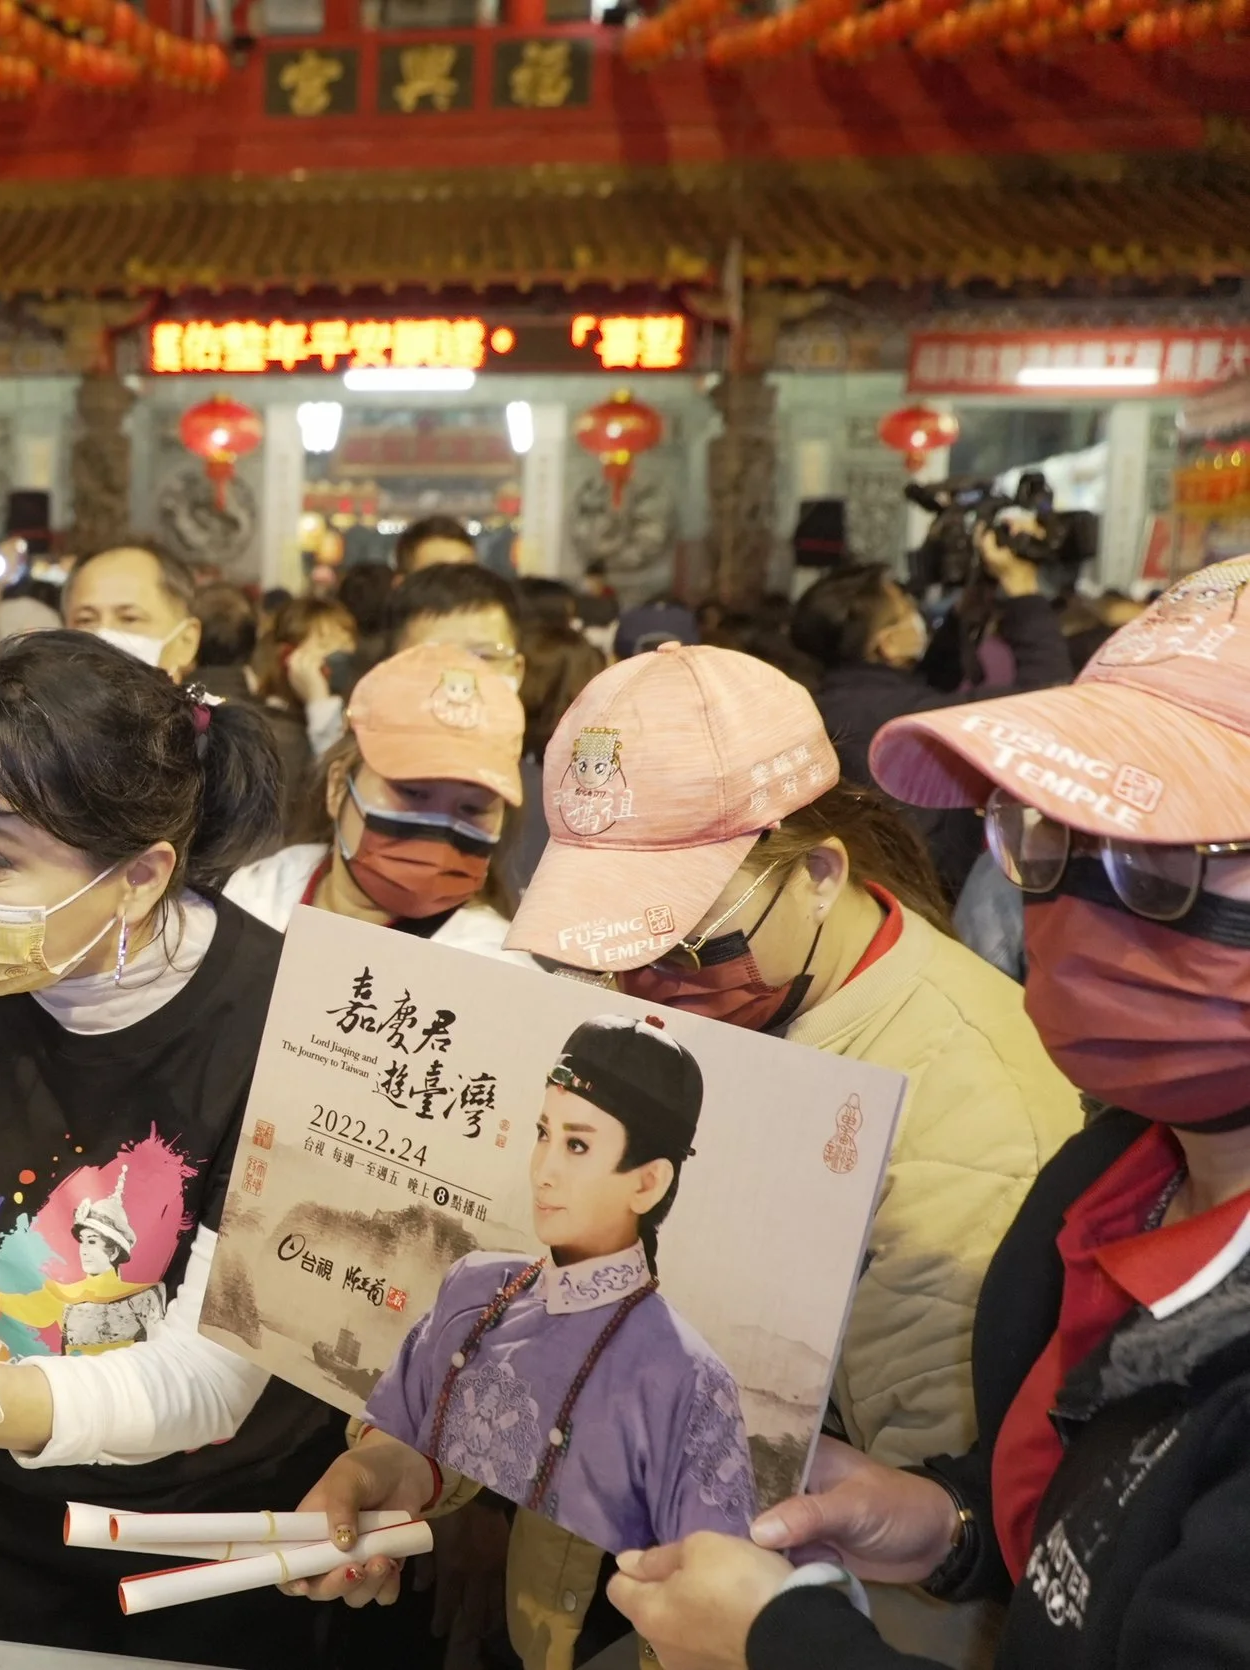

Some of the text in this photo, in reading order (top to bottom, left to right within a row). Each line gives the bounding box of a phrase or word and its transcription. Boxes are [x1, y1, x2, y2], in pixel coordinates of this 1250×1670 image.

[961, 714, 1117, 781] FUSING
[993, 740, 1144, 832] TEMPLE
[558, 916, 644, 951] FUSING
[582, 934, 673, 966] TEMPLE
[326, 966, 458, 1055] 嘉慶君
[282, 1039, 370, 1078] The Journey to Taiwan
[310, 1034, 379, 1065] Lord Jiaqing and
[309, 1104, 428, 1167] 2022.2.24
[303, 1135, 325, 1157] 台視
[332, 1148, 401, 1187] 每週一至週五
[300, 1251, 334, 1281] 台視
